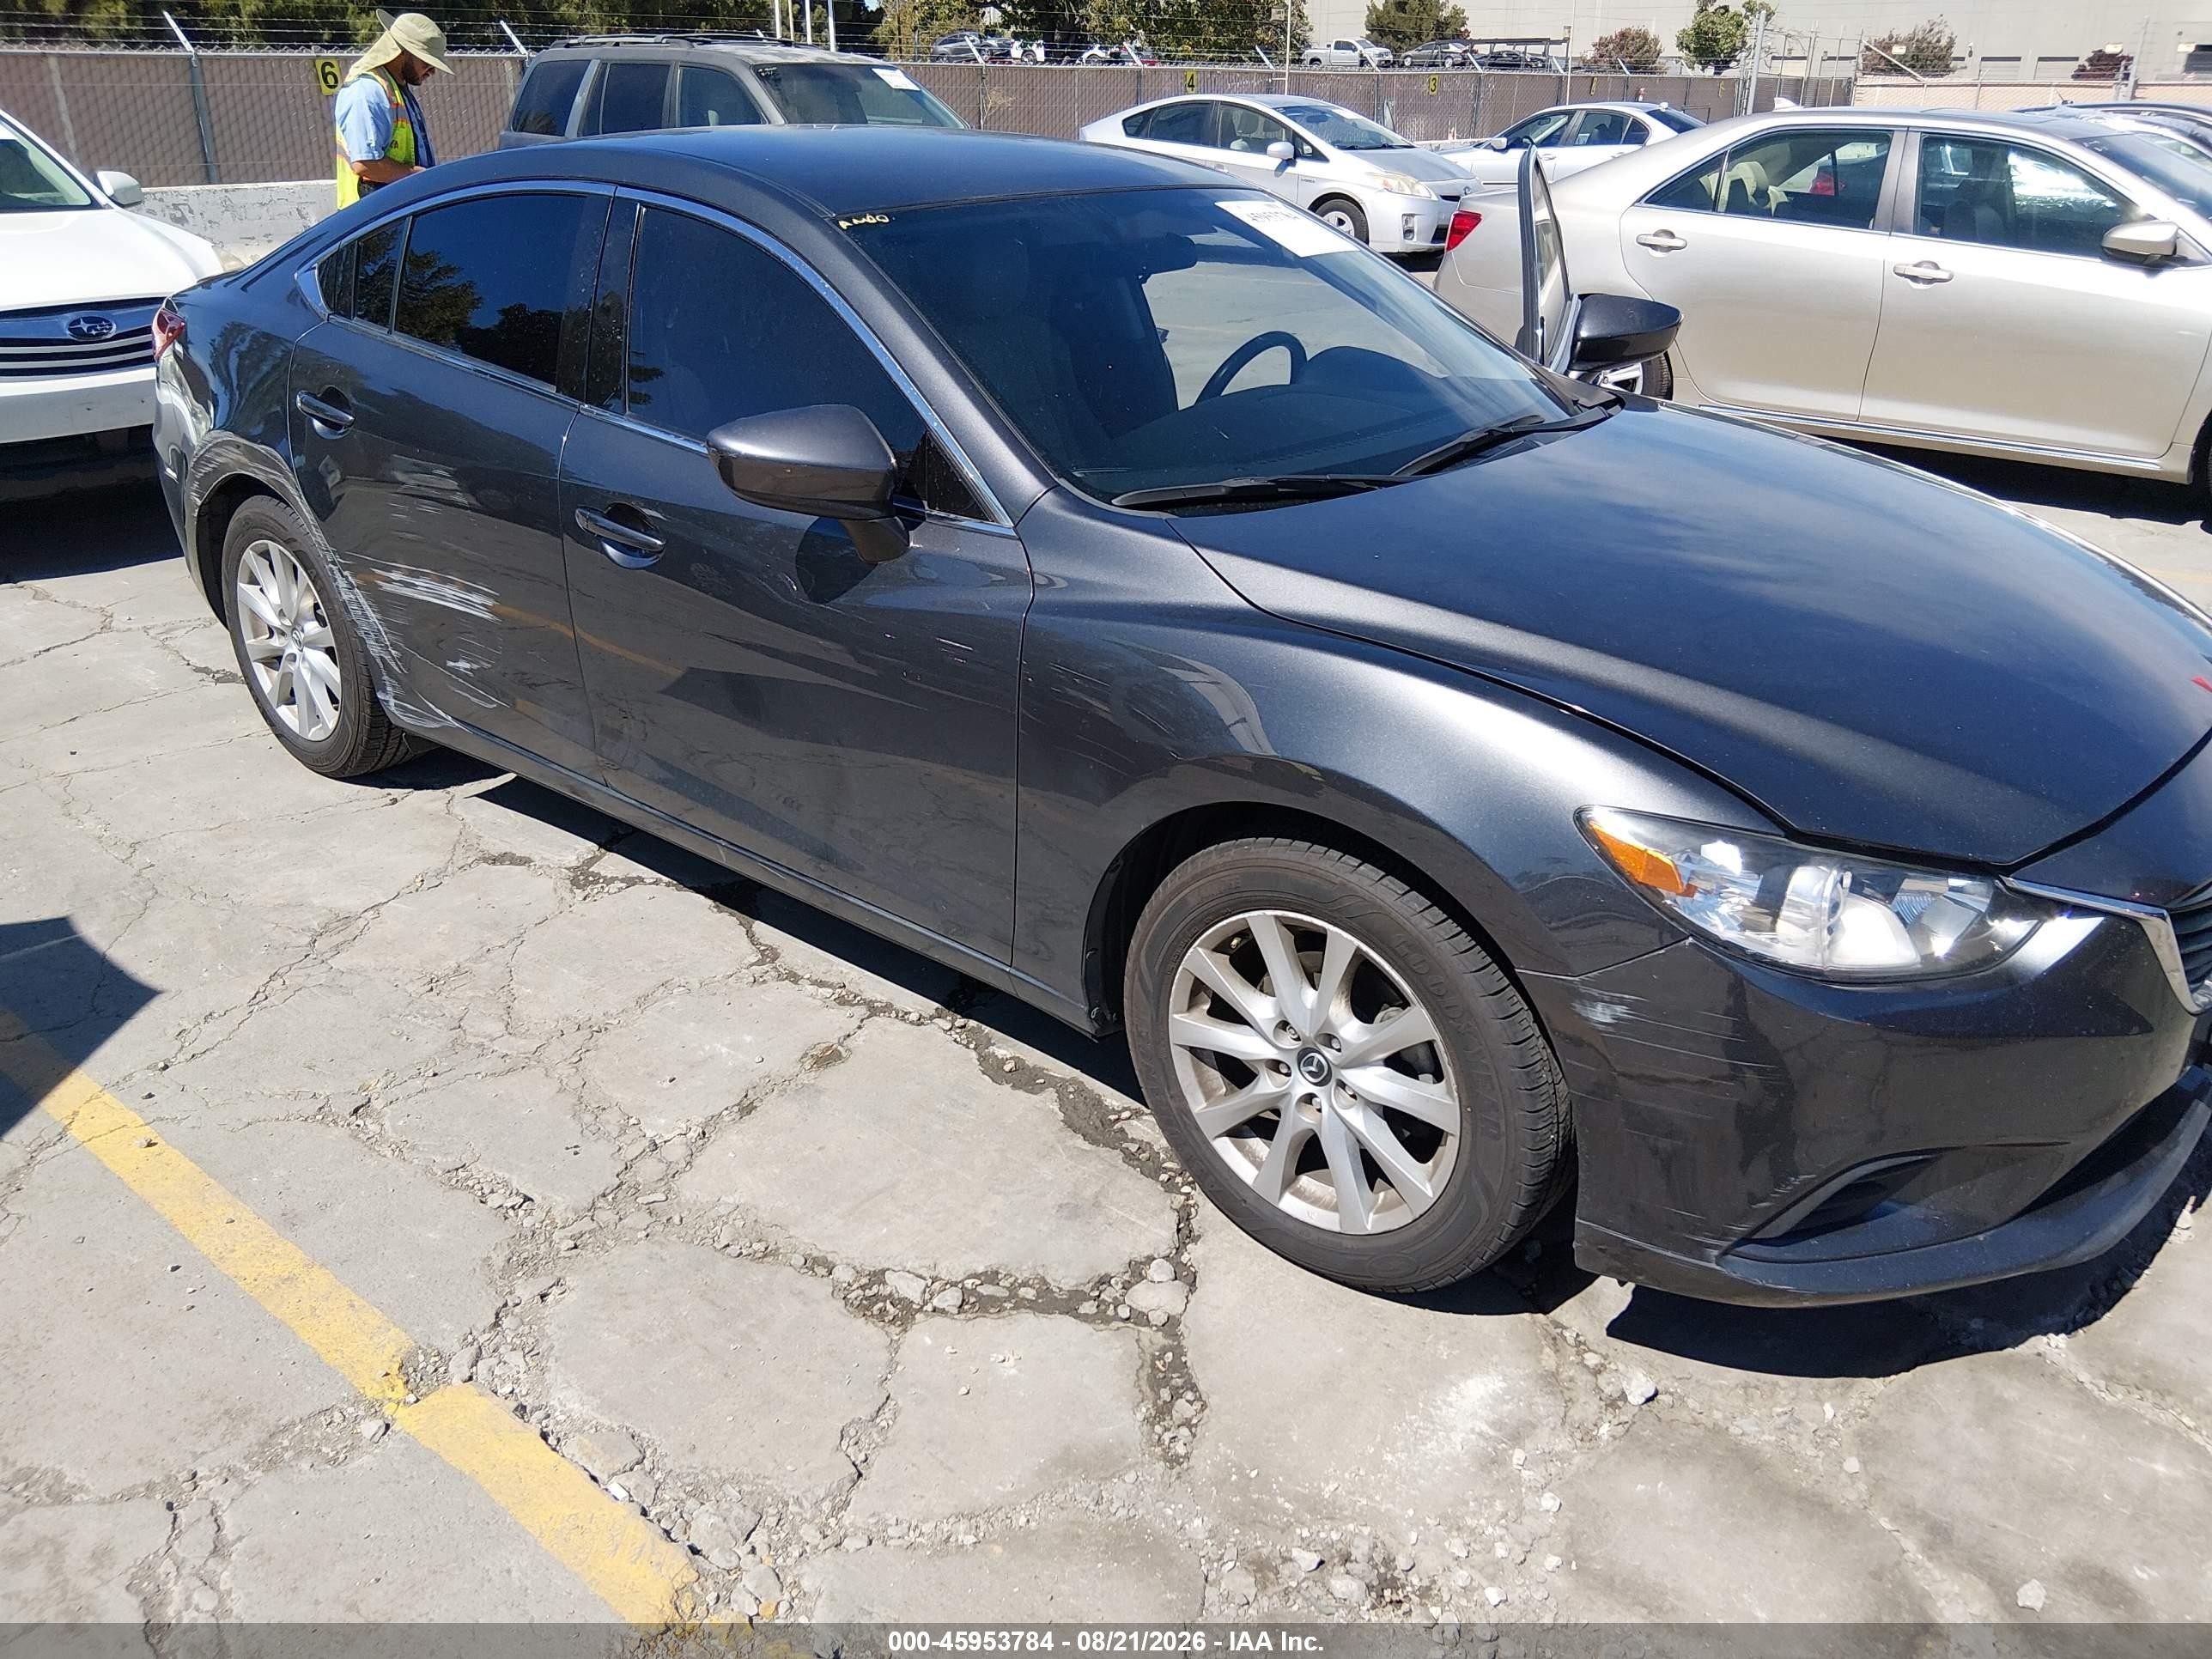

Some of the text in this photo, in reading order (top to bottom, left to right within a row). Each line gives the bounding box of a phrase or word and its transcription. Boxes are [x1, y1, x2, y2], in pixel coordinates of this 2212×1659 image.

[321, 62, 338, 89] 6
[1188, 74, 1195, 91] 4
[1430, 77, 1437, 93] 3
